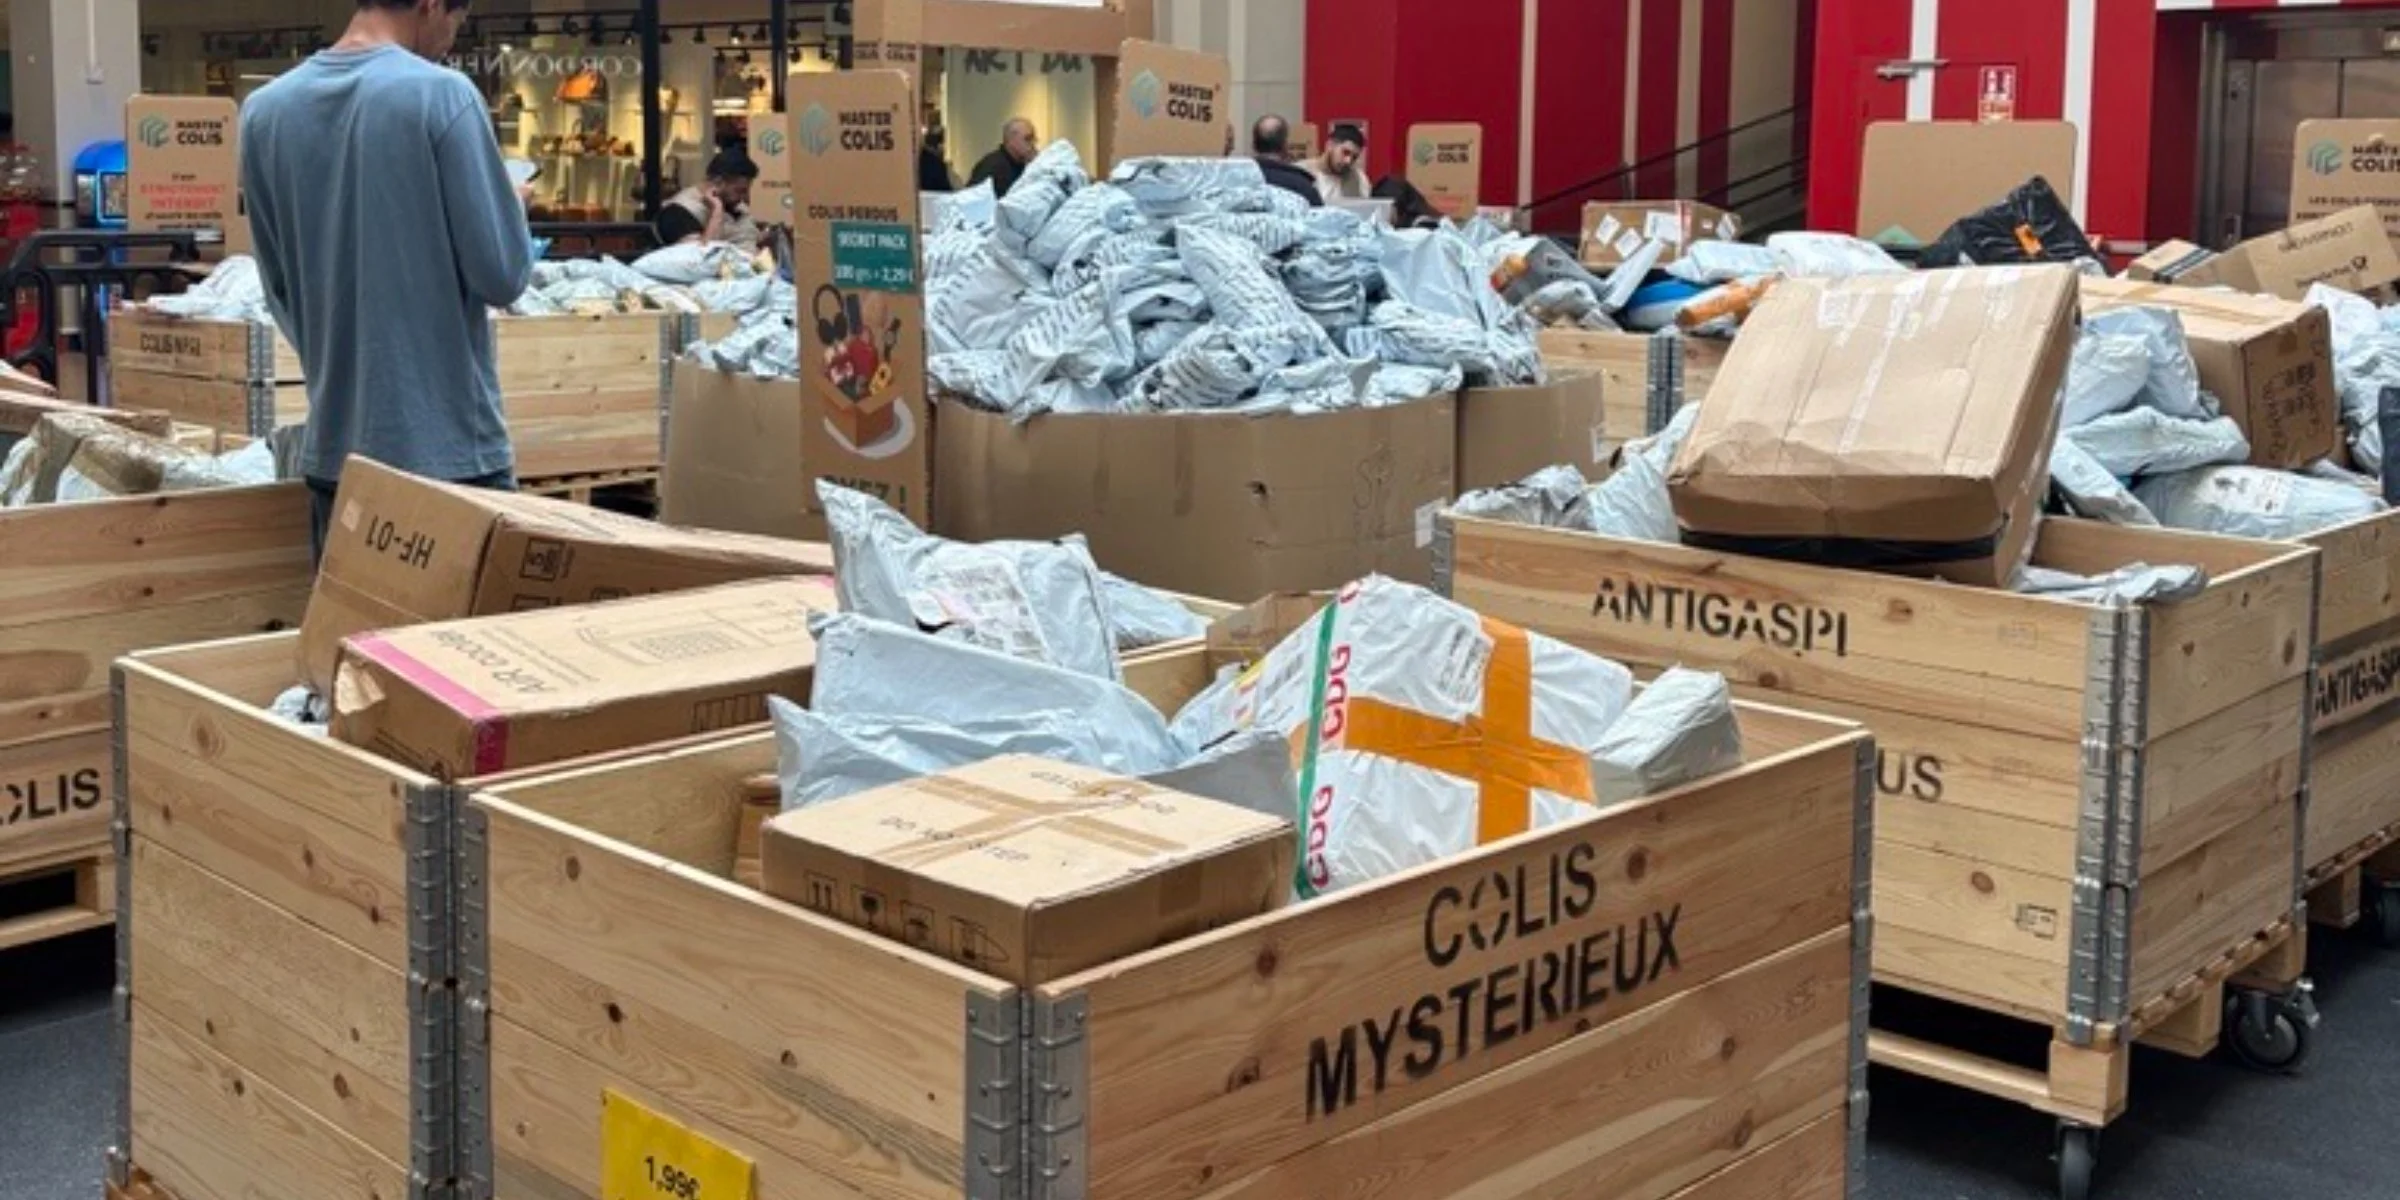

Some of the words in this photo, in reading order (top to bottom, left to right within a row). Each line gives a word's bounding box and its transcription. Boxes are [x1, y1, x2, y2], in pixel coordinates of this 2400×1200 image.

[1168, 82, 1213, 101] MASTER
[838, 111, 892, 126] MASTER
[1167, 98, 1213, 123] COLIS
[176, 119, 223, 129] MASTER
[176, 131, 224, 146] COLIS
[839, 129, 895, 151] COLIS
[1437, 152, 1469, 164] COLIS
[808, 205, 845, 219] COLIS
[848, 205, 899, 222] PERDUS
[837, 230, 877, 249] SECRET
[878, 233, 907, 251] PACK
[365, 515, 436, 570] HF-01
[1592, 577, 1848, 657] ANTIGASPI
[1320, 645, 1352, 741] CDG
[1308, 785, 1333, 889] CDG
[1424, 842, 1598, 967] COLIS
[1306, 903, 1682, 1123] MYSTERIEUX
